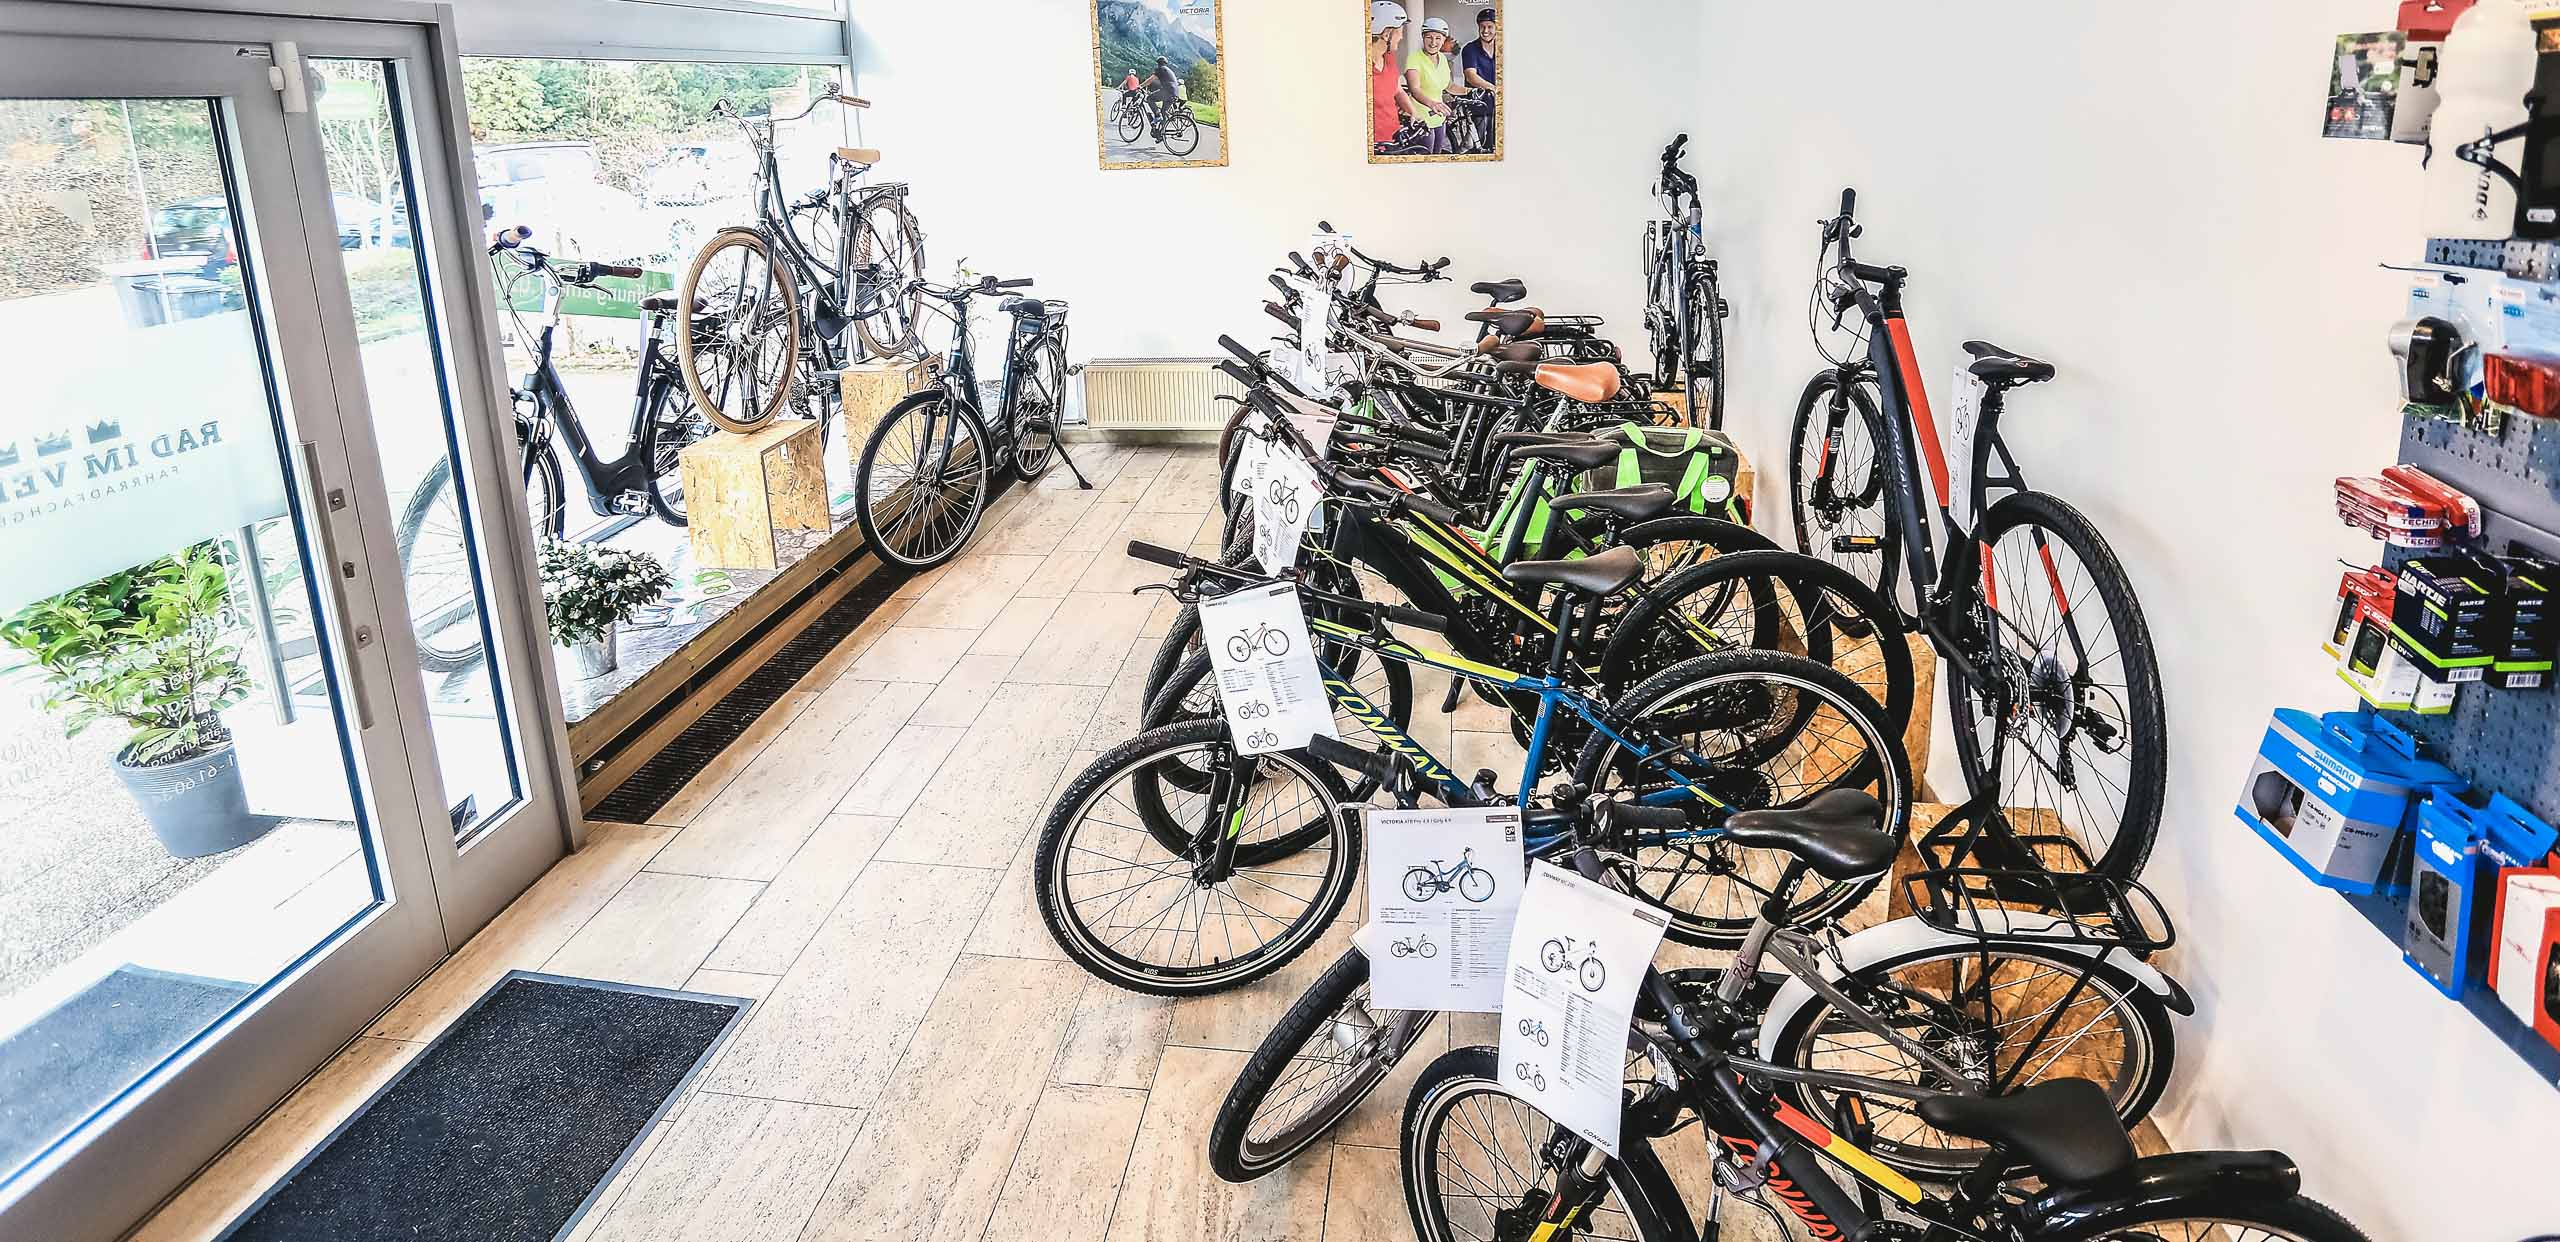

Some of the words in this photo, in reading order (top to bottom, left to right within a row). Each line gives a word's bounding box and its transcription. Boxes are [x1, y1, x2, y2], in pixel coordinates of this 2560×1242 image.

[2399, 569, 2448, 608] HARTJE
[2313, 749, 2357, 784] SHIMANO
[1667, 832, 1724, 846] CONWAY
[1143, 967, 1159, 976] KIDS
